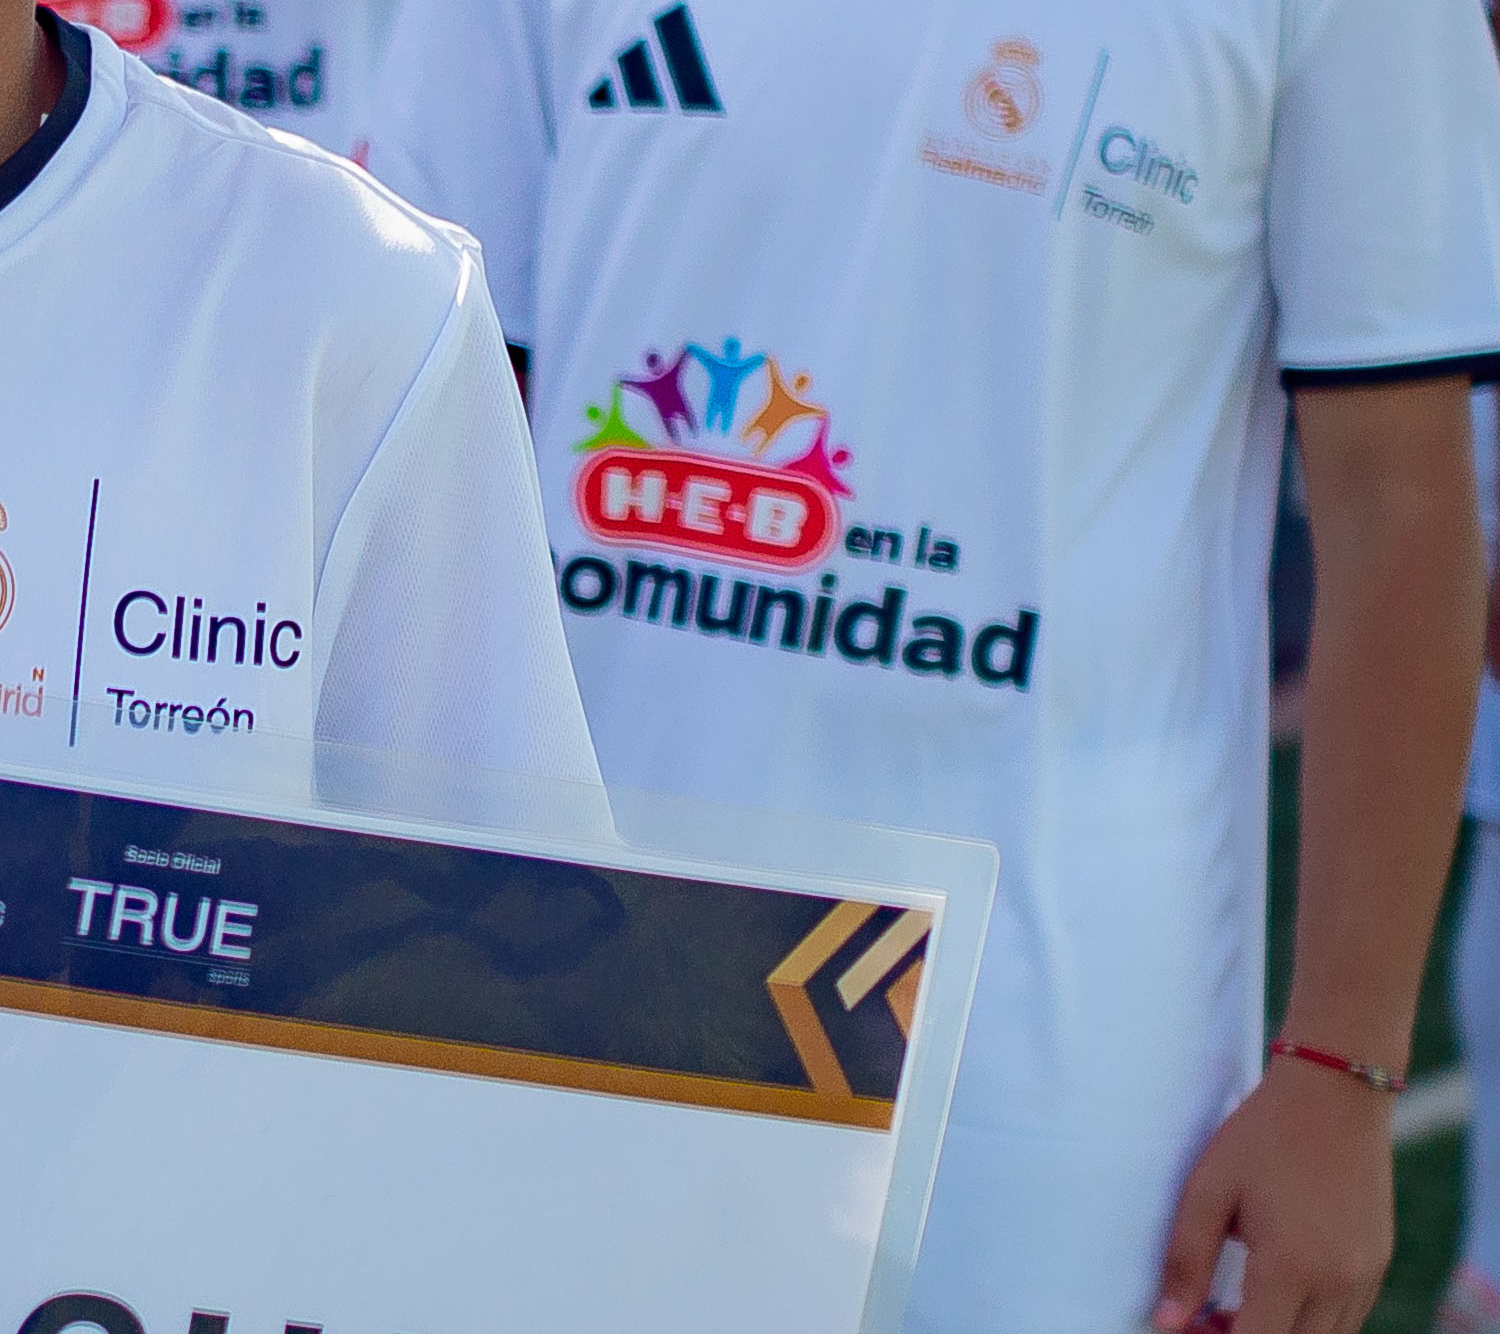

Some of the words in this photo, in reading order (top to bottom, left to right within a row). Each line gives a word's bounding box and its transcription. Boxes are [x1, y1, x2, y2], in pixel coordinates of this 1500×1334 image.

[1099, 125, 1199, 205] Clinic
[845, 525, 904, 563] en
[913, 524, 961, 571] la
[113, 590, 303, 670] Clinic
[552, 551, 1039, 694] omunidad
[106, 687, 255, 734] Torreón
[67, 877, 259, 960] TRUE
